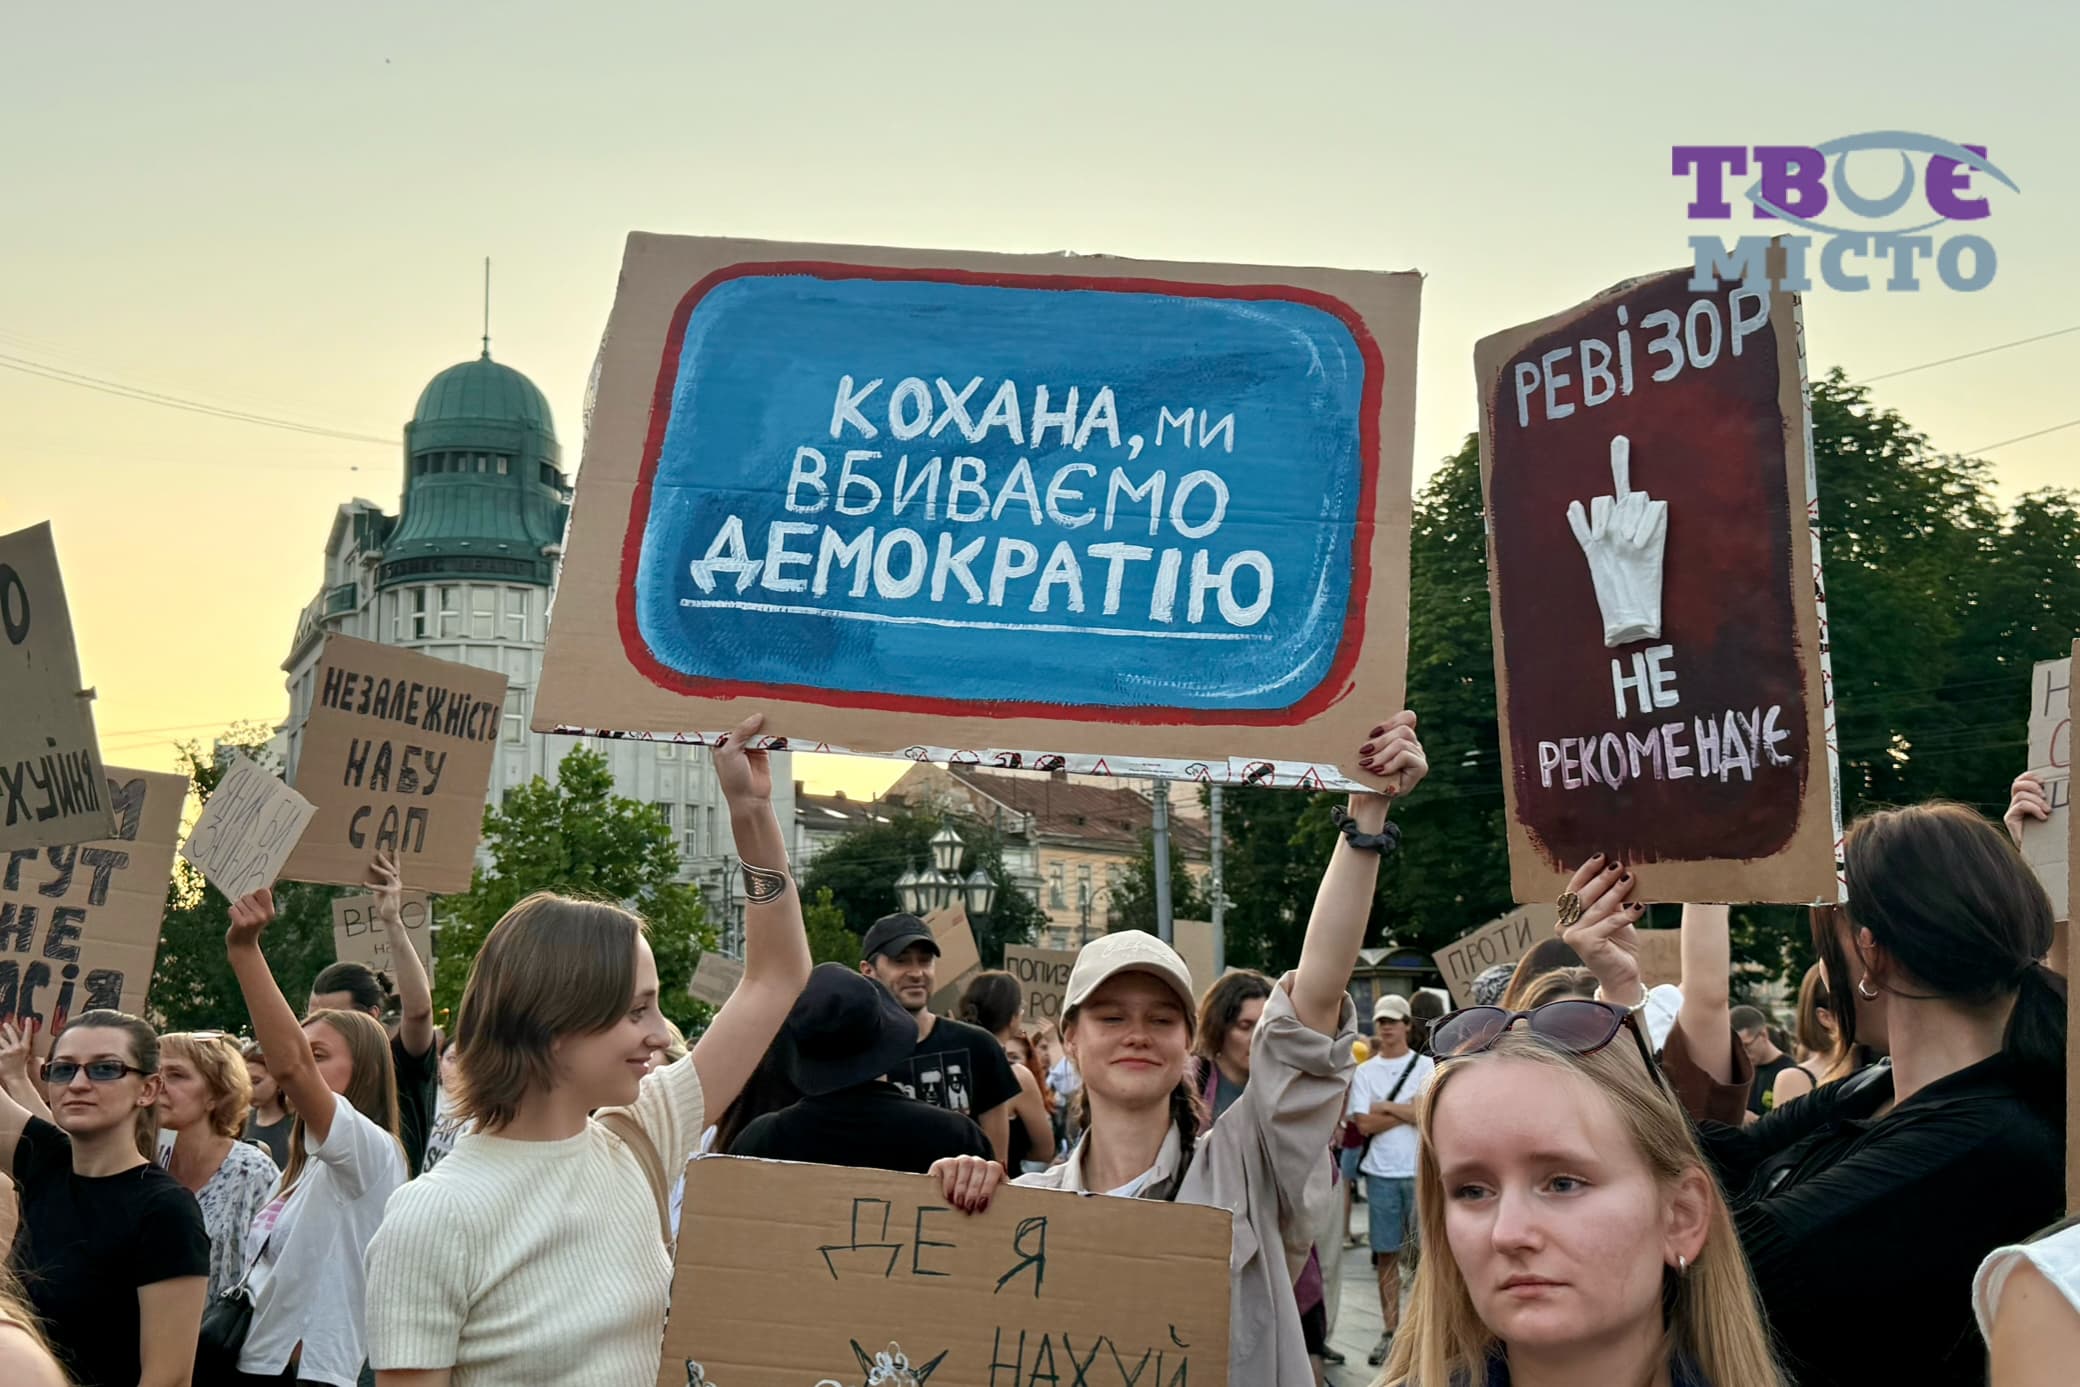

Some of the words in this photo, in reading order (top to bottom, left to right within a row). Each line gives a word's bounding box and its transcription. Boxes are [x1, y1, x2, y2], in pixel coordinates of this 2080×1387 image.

[830, 375, 1144, 460] КОХАНА,
[785, 446, 1230, 538] ВБИВАЄМО
[690, 515, 1274, 626] ДЕМОКРАТІЮ
[1611, 644, 1680, 718] НЕ
[344, 738, 447, 795] НАБУ
[349, 804, 429, 853] САП
[1447, 917, 1533, 980] ПРОТИ
[817, 1197, 957, 1280] ДЕ
[994, 1216, 1048, 1298] Я
